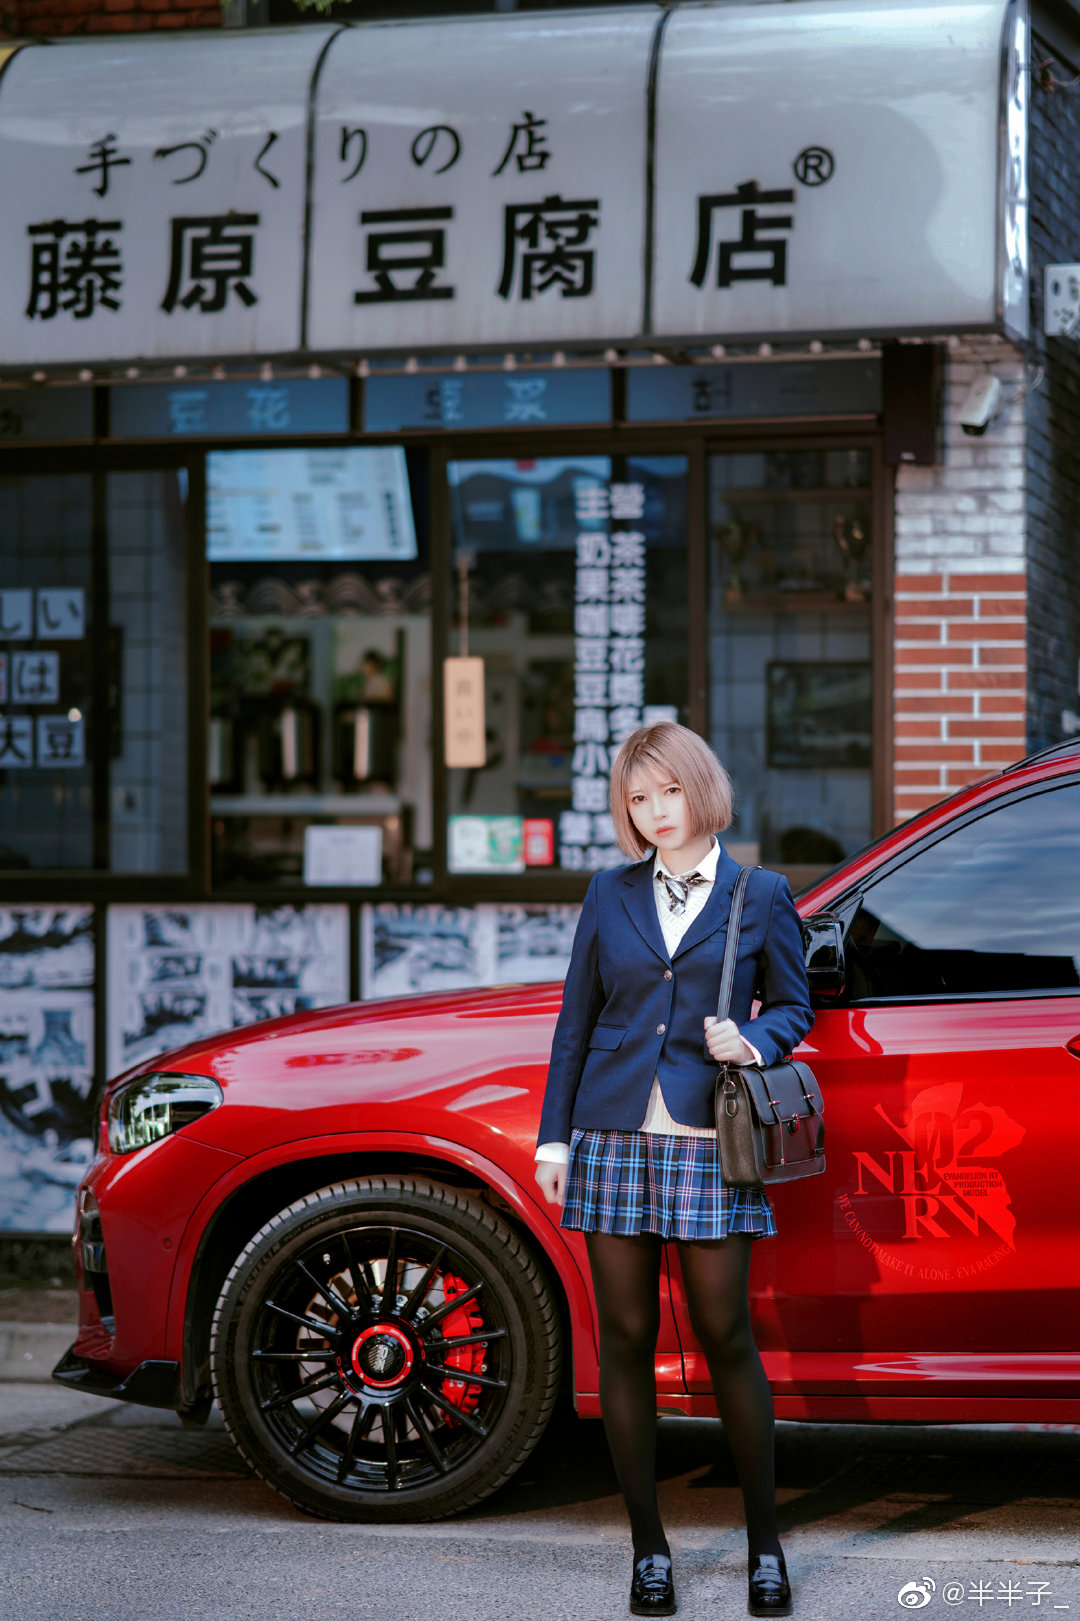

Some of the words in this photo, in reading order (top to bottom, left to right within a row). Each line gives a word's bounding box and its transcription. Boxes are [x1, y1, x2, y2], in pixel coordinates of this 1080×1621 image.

[76, 111, 551, 196] 手づくりの店
[26, 181, 795, 320] 藤原豆腐店
[575, 532, 646, 567] 奶茶
[575, 567, 646, 602] 果茶
[575, 638, 646, 672] 豆花
[953, 1180, 1003, 1189] PRODUCTION
[962, 1188, 988, 1197] MODEL
